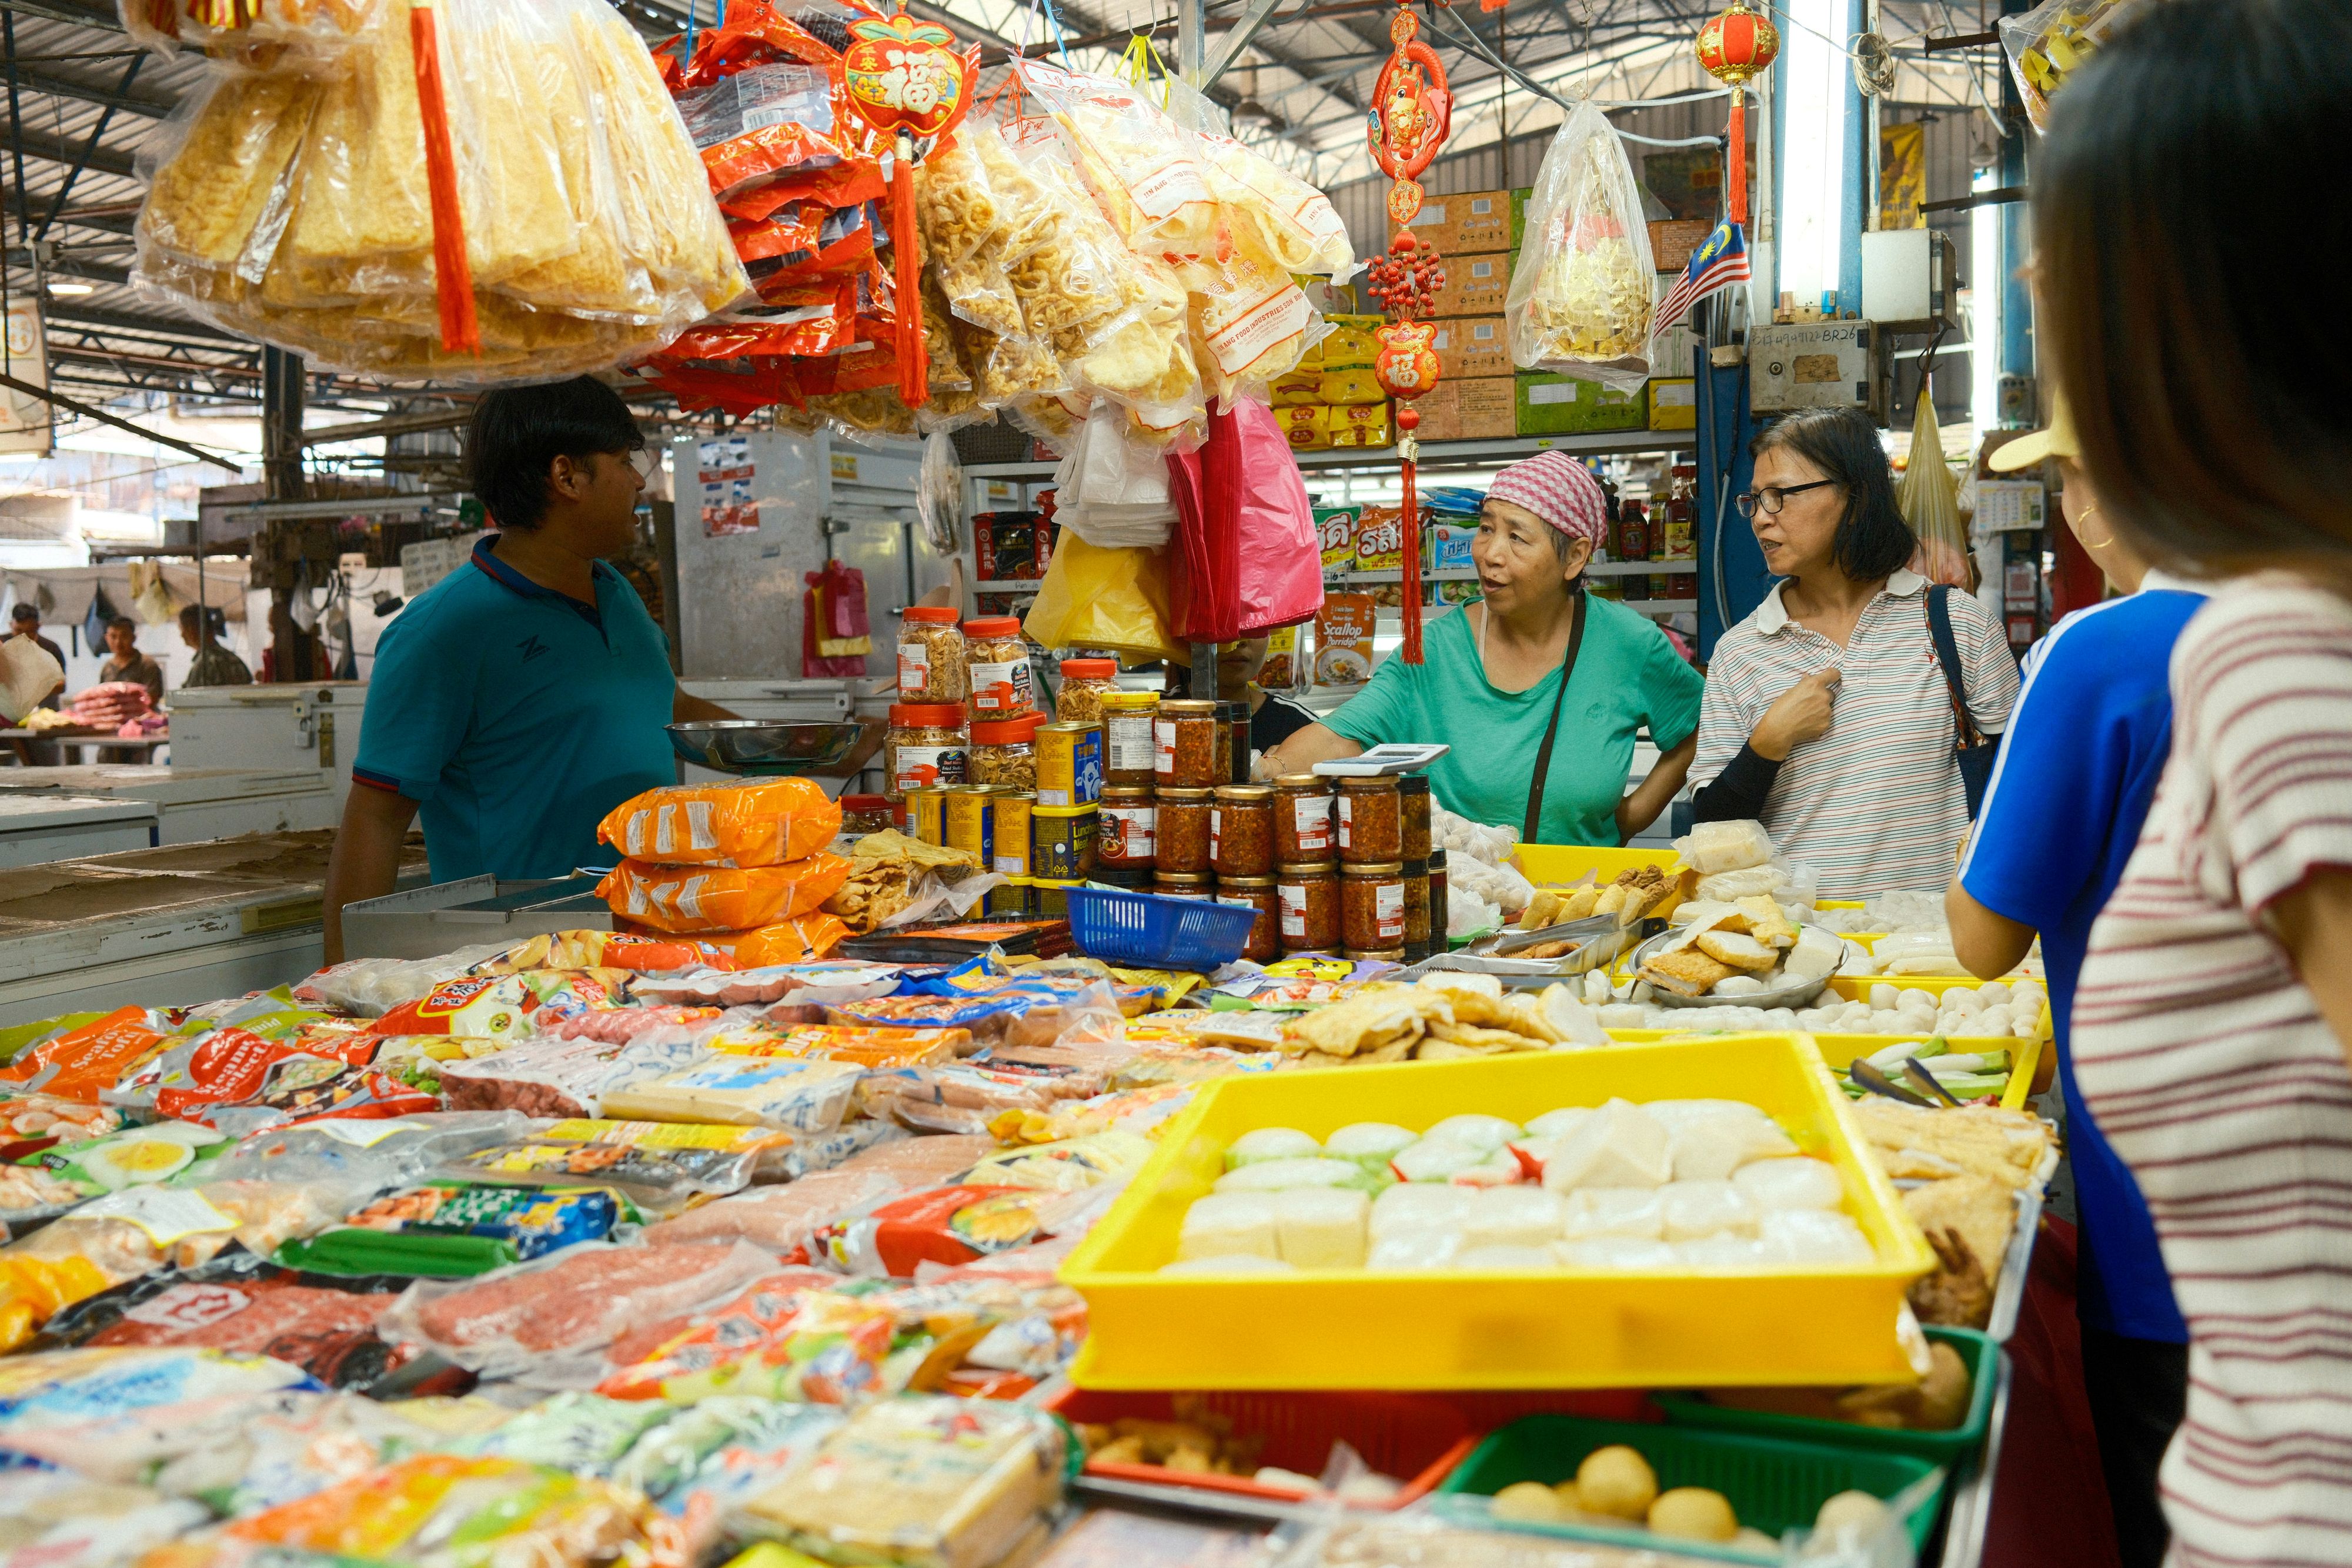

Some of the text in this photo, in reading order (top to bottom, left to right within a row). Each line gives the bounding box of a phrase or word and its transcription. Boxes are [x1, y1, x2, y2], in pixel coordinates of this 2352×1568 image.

[879, 49, 939, 115] 福
[1224, 337, 1235, 350] ANG
[1235, 327, 1250, 340] FOOD
[1250, 305, 1284, 330] INDUSTRIES
[1283, 299, 1294, 309] SDN
[1822, 325, 1856, 342] BR26
[1386, 354, 1420, 389] 福
[1324, 621, 1362, 637] Scallop
[1327, 636, 1358, 648] Porridge
[1073, 839, 1088, 852] Meat
[70, 1029, 118, 1069] Seafo
[99, 1029, 141, 1060] Tofu
